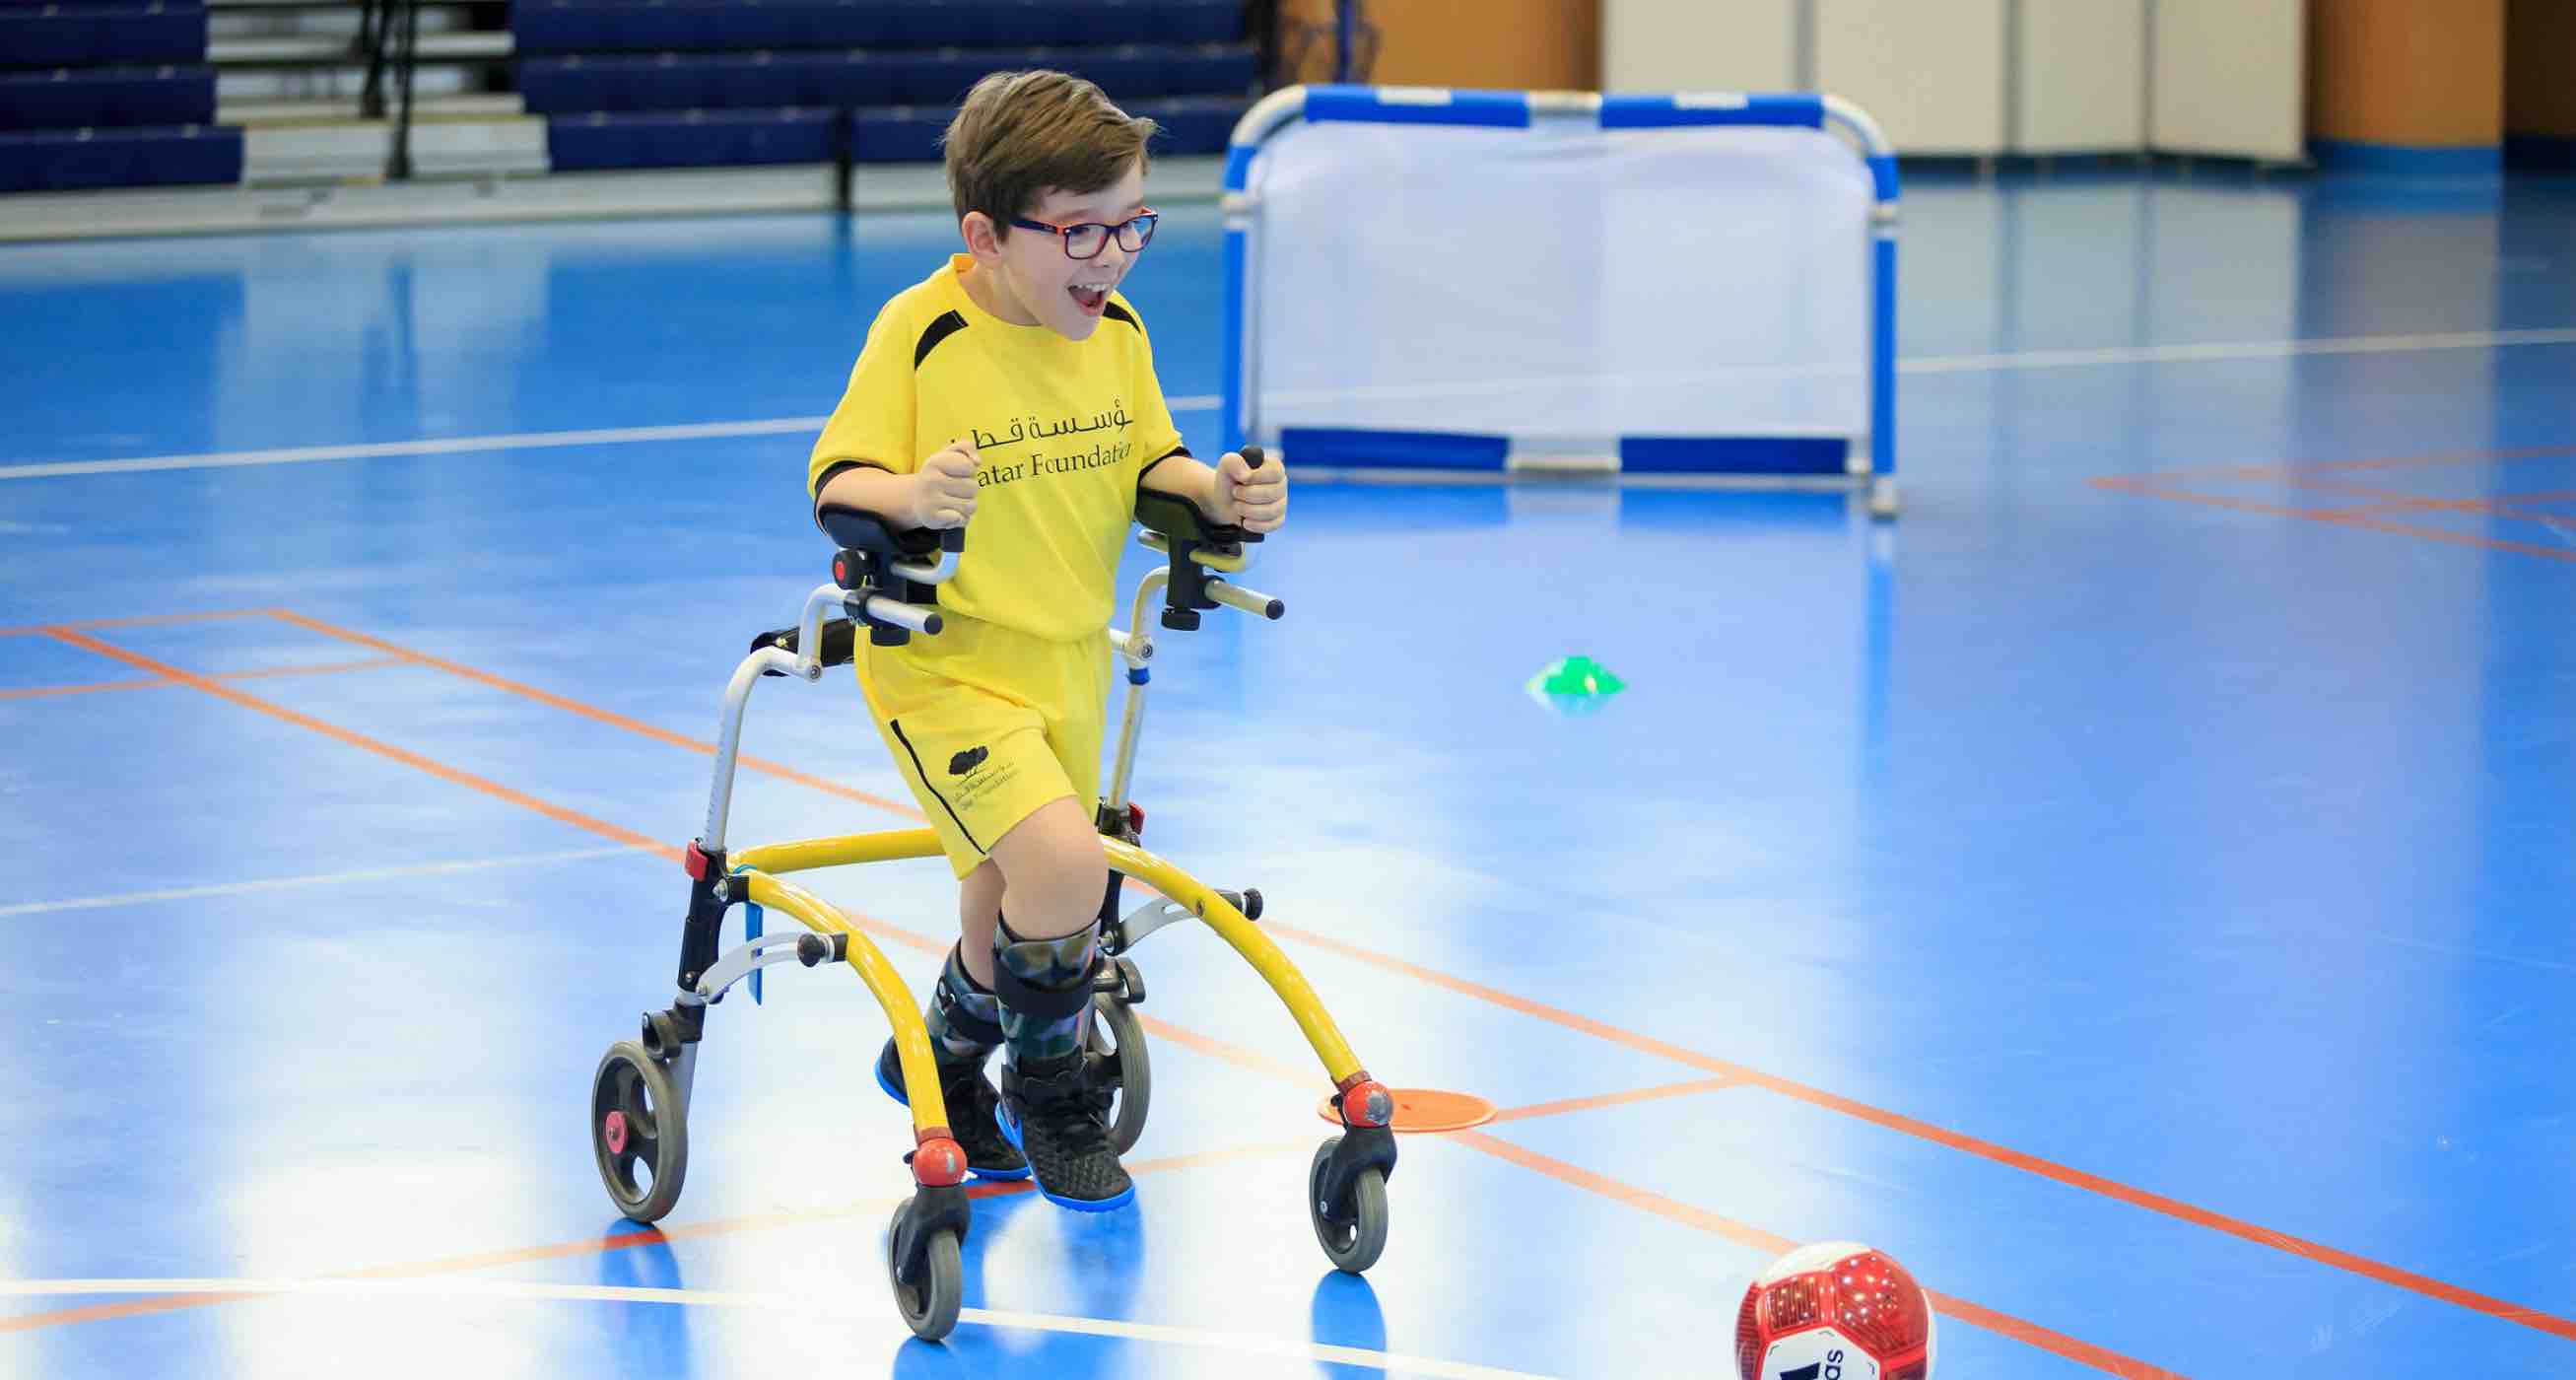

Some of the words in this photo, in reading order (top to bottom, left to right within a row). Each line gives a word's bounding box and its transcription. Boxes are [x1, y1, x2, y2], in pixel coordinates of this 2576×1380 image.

[971, 417, 1025, 450] قط
[1028, 398, 1134, 440] ؤسسة
[977, 463, 1025, 488] atar
